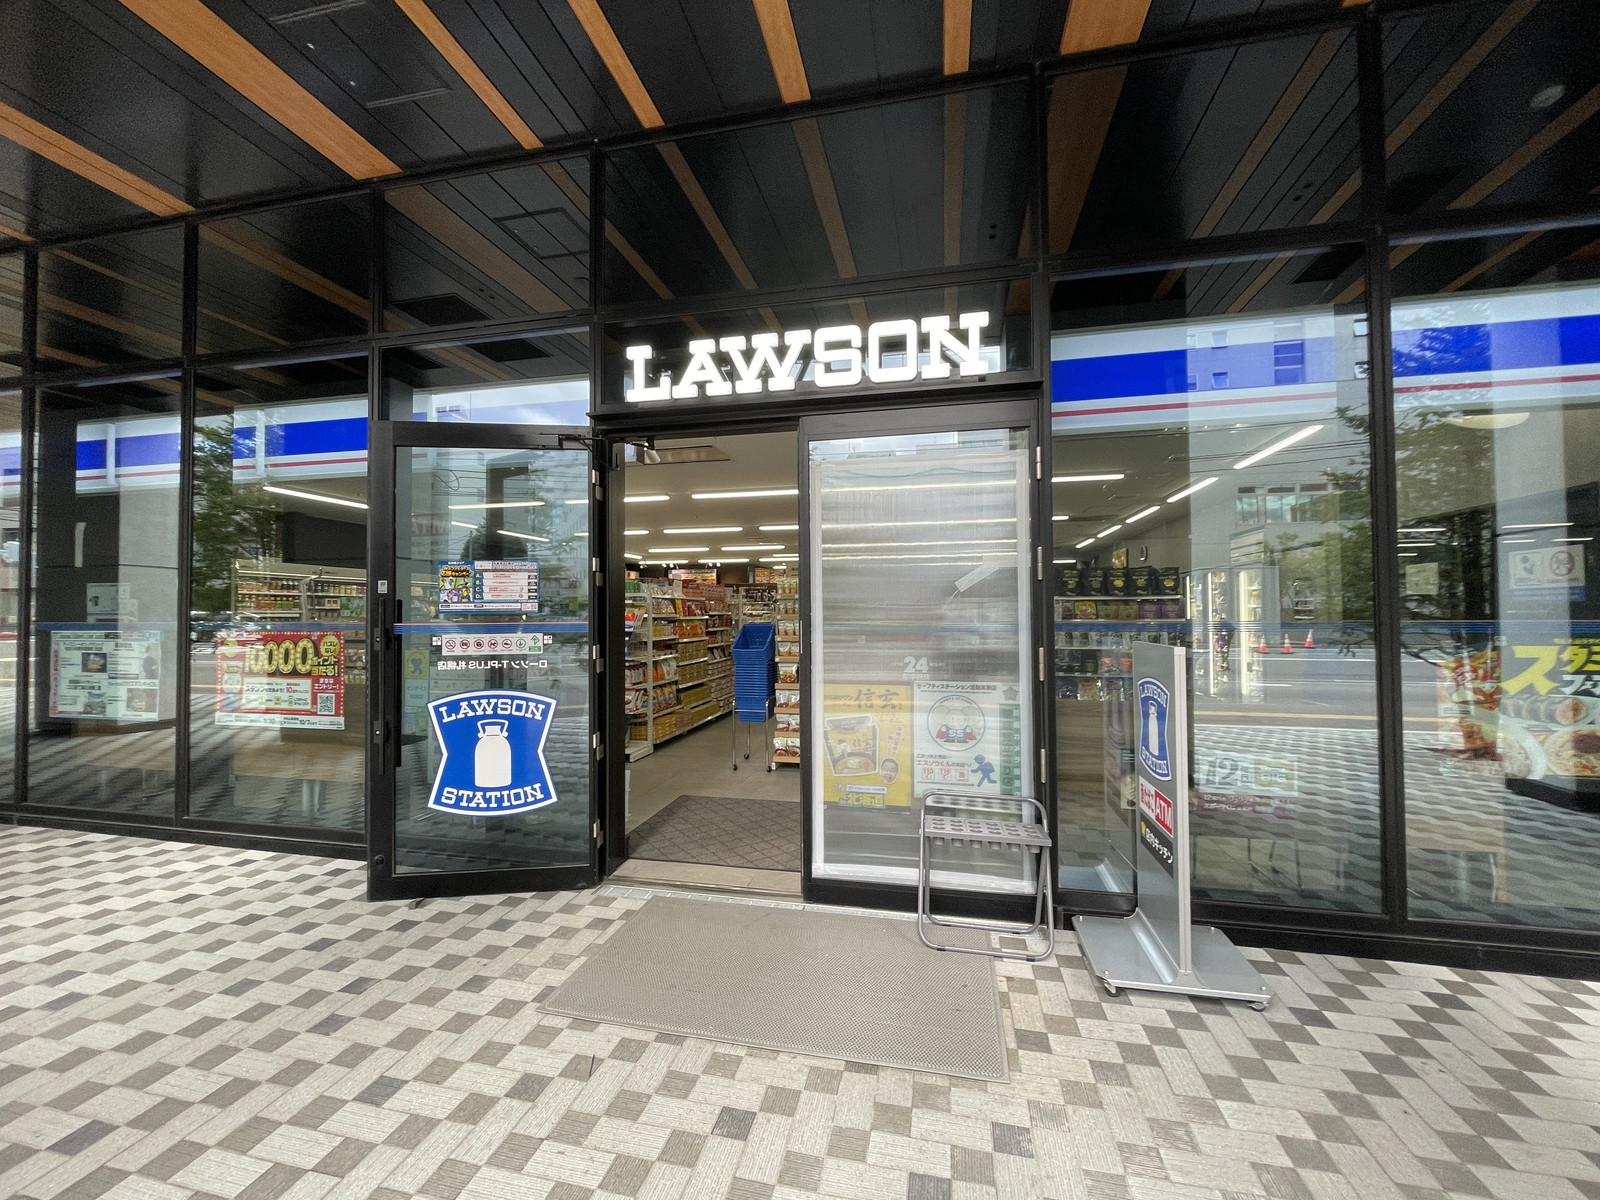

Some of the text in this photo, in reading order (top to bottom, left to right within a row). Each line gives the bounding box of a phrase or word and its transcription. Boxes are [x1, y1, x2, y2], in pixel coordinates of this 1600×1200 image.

[625, 310, 990, 403] LAWSON
[903, 656, 929, 674] 24
[1140, 682, 1167, 708] LAWSON
[439, 698, 546, 724] LAWSON
[948, 729, 964, 738] SS
[1141, 746, 1169, 775] STATION
[440, 782, 546, 808] STATION
[1155, 796, 1173, 830] ATM
